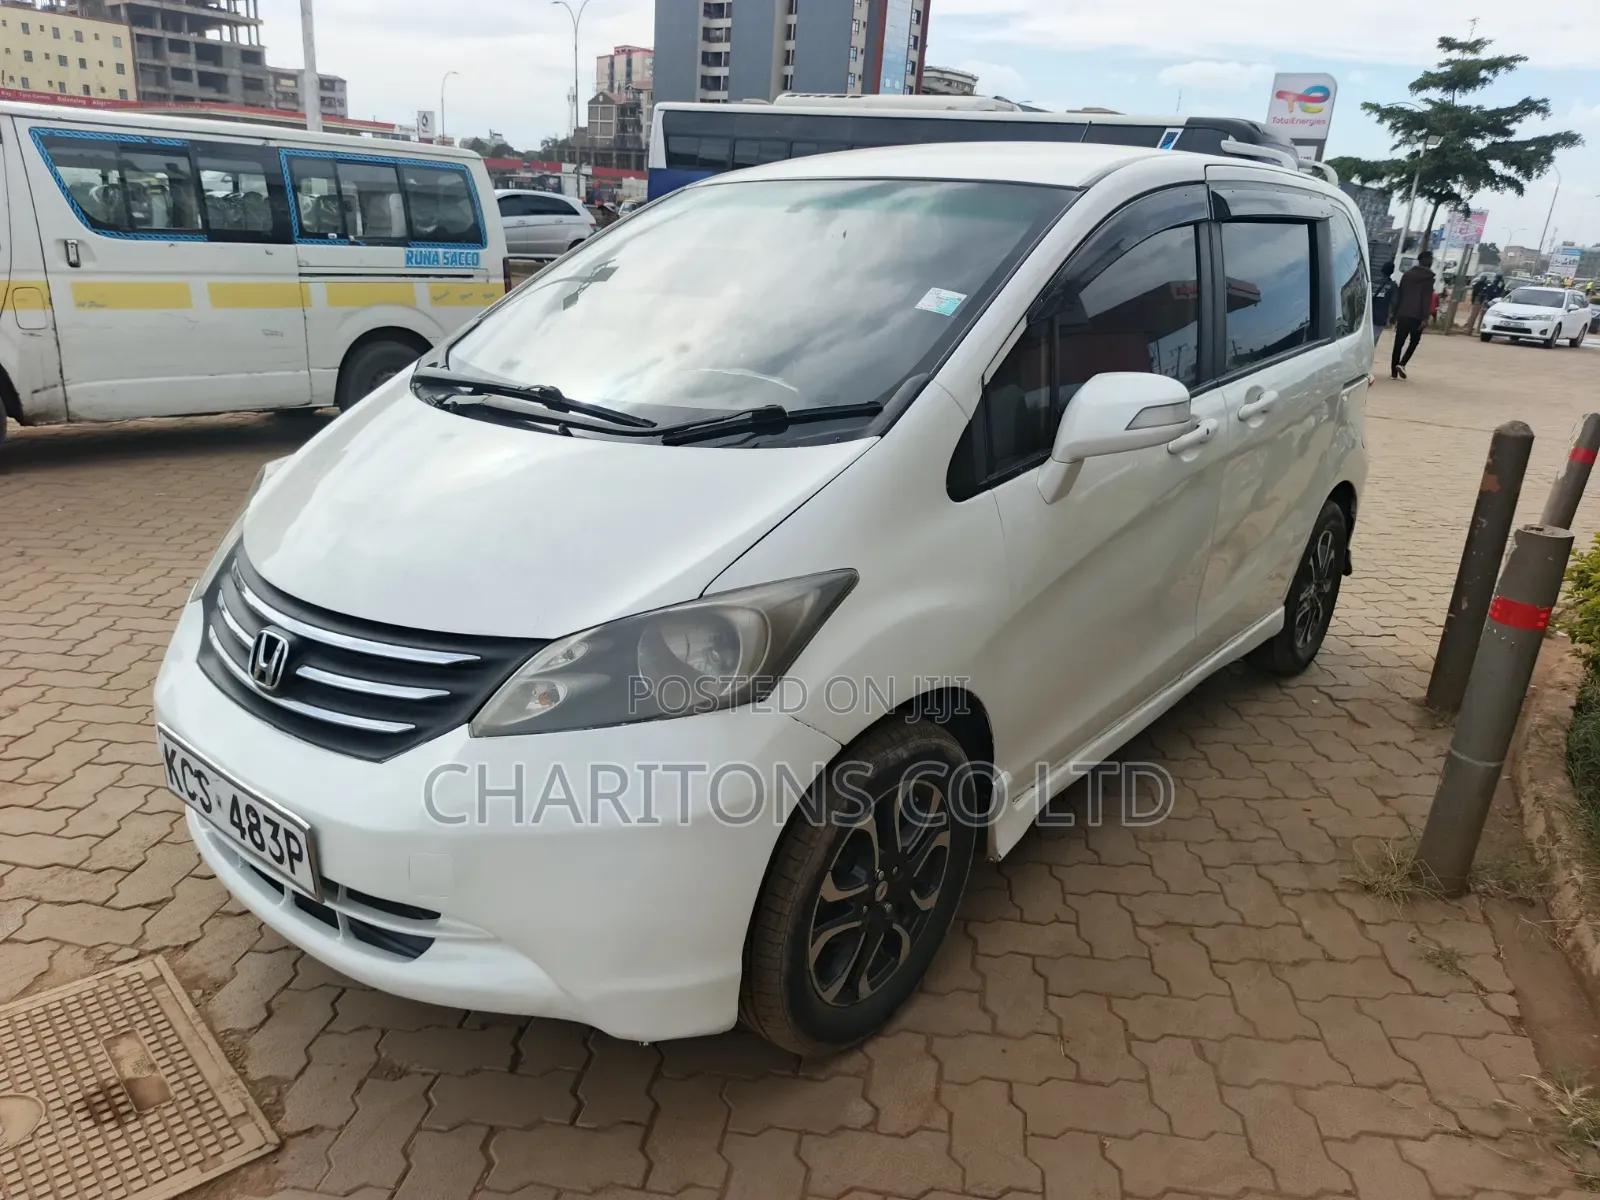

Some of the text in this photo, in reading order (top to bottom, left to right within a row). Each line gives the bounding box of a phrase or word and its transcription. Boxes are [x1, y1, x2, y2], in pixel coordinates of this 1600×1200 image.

[57, 96, 86, 106] Balancing
[1272, 117, 1326, 127] TotalEnergies
[443, 251, 479, 267] SACCO
[164, 743, 303, 875] KCS 483P
